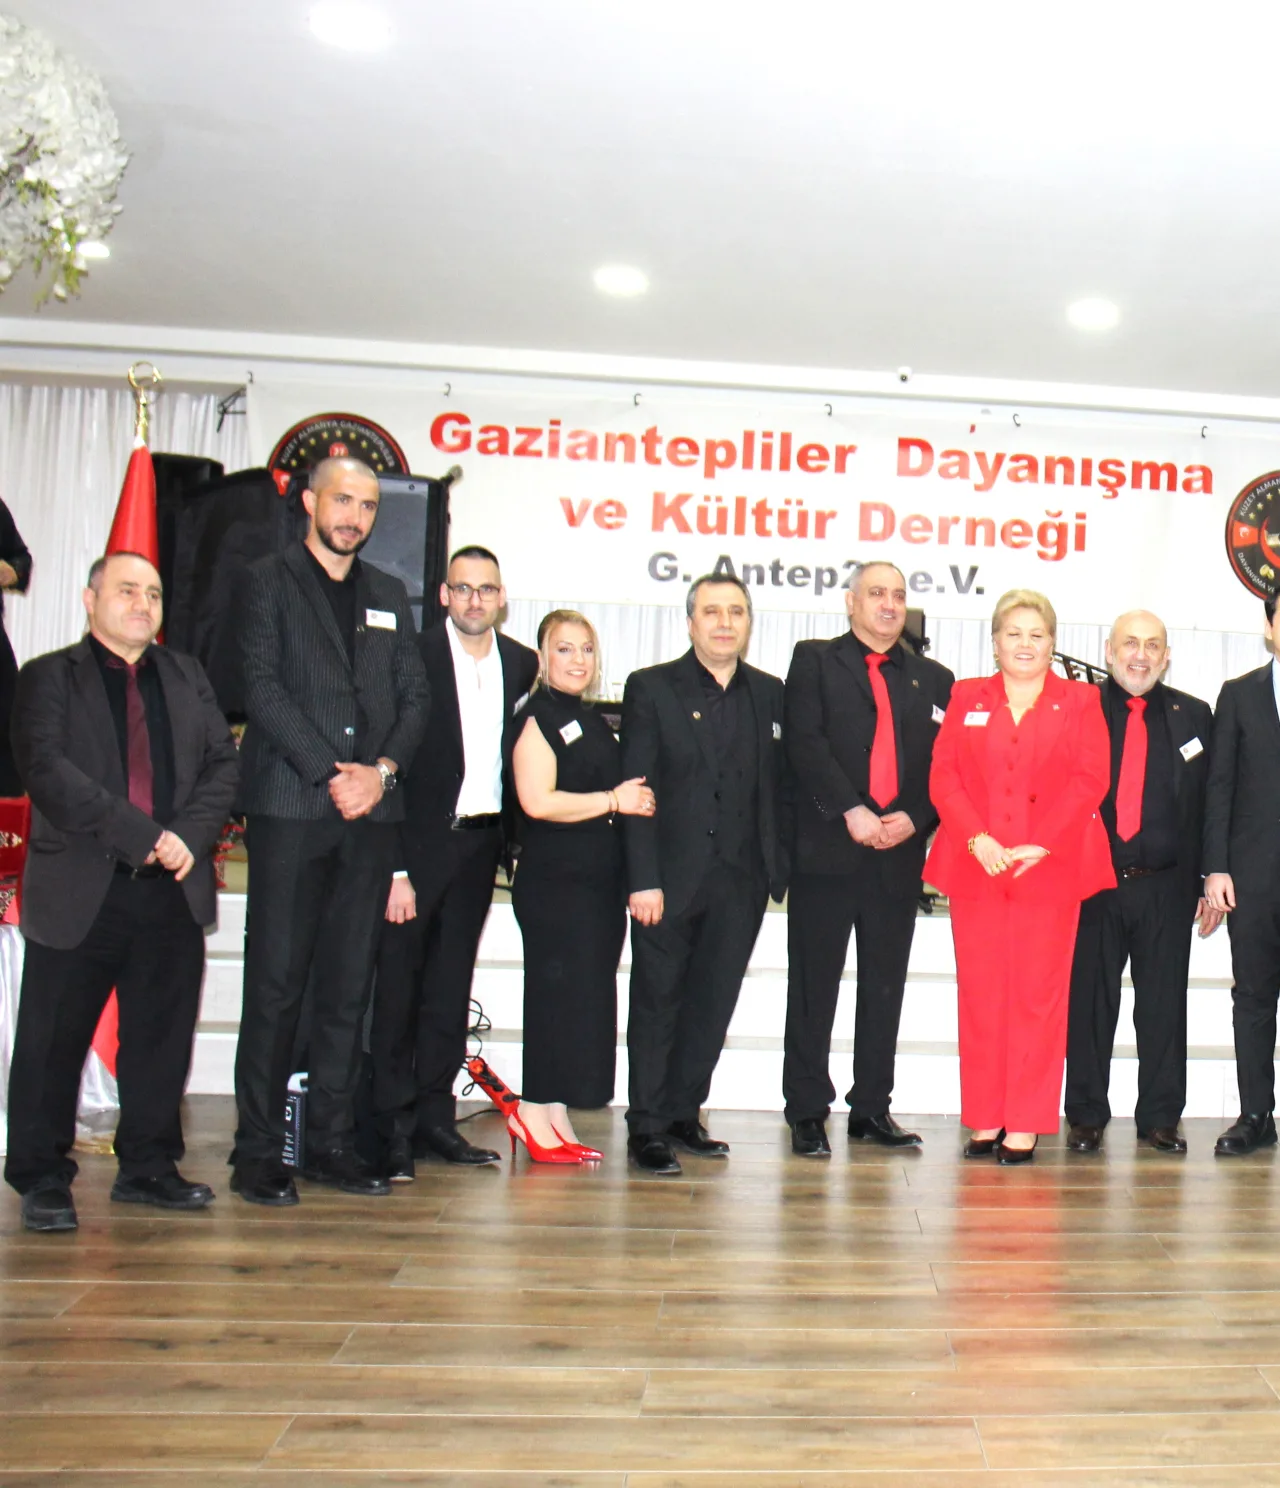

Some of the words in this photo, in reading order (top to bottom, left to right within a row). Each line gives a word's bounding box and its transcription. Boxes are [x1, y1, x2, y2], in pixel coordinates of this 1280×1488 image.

[430, 411, 857, 479] Gaziantepliler
[897, 437, 1214, 499] Dayanışma
[560, 497, 627, 530] ve
[651, 491, 838, 540] Kültür
[859, 501, 1087, 562] Derneği
[1240, 492, 1256, 517] KUZEY
[648, 552, 692, 582] G.
[711, 554, 866, 596] Antep2
[908, 564, 985, 595] e.V.
